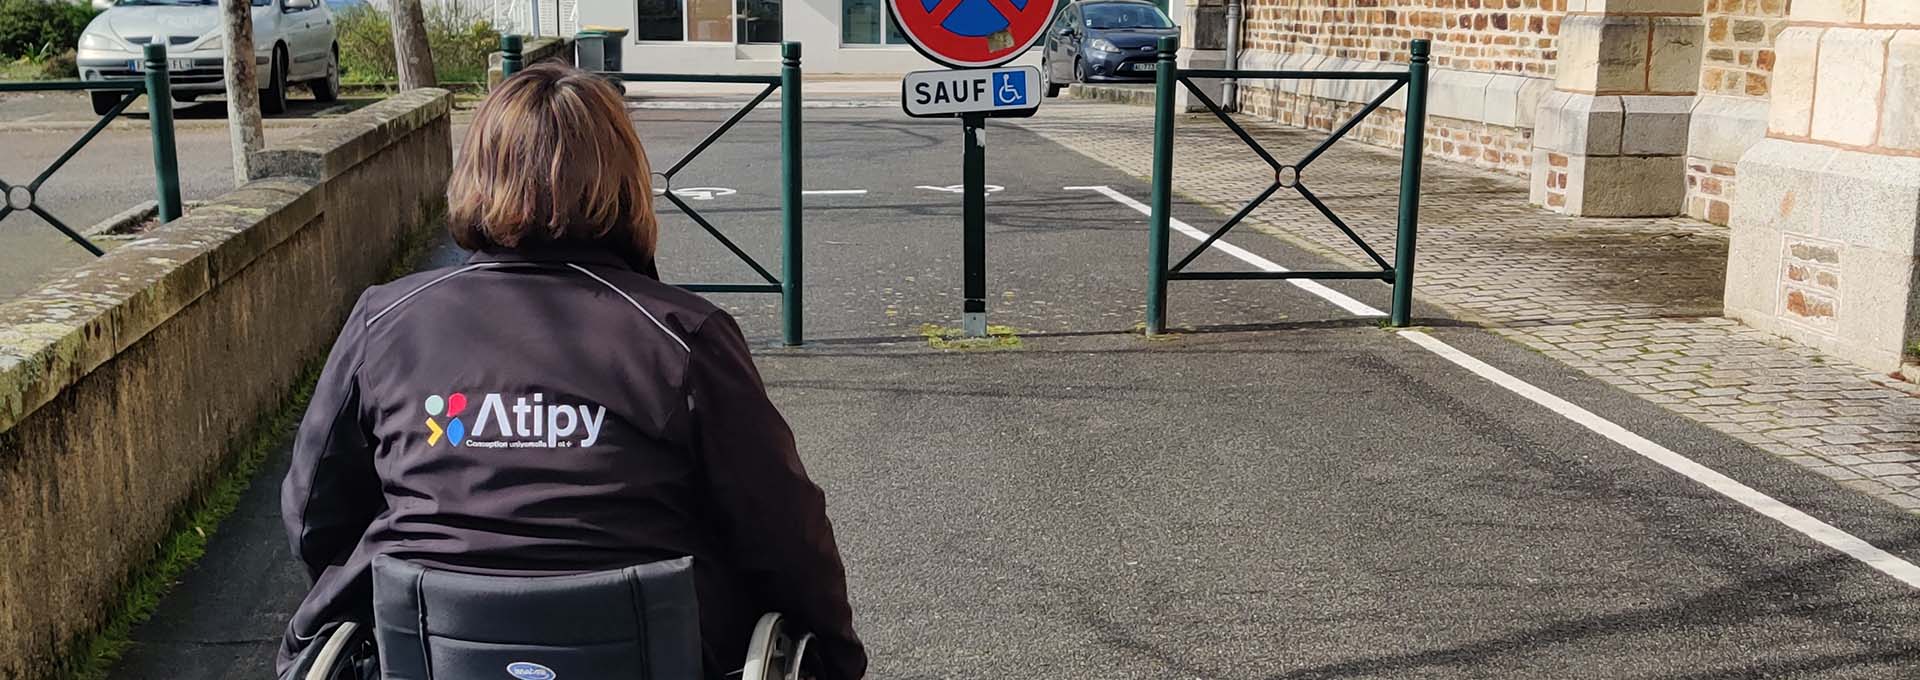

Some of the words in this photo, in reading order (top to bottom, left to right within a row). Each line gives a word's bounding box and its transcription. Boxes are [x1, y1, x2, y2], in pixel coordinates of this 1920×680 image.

[915, 79, 986, 105] SAUF
[471, 393, 606, 447] Atipy
[466, 440, 508, 448] Conception
